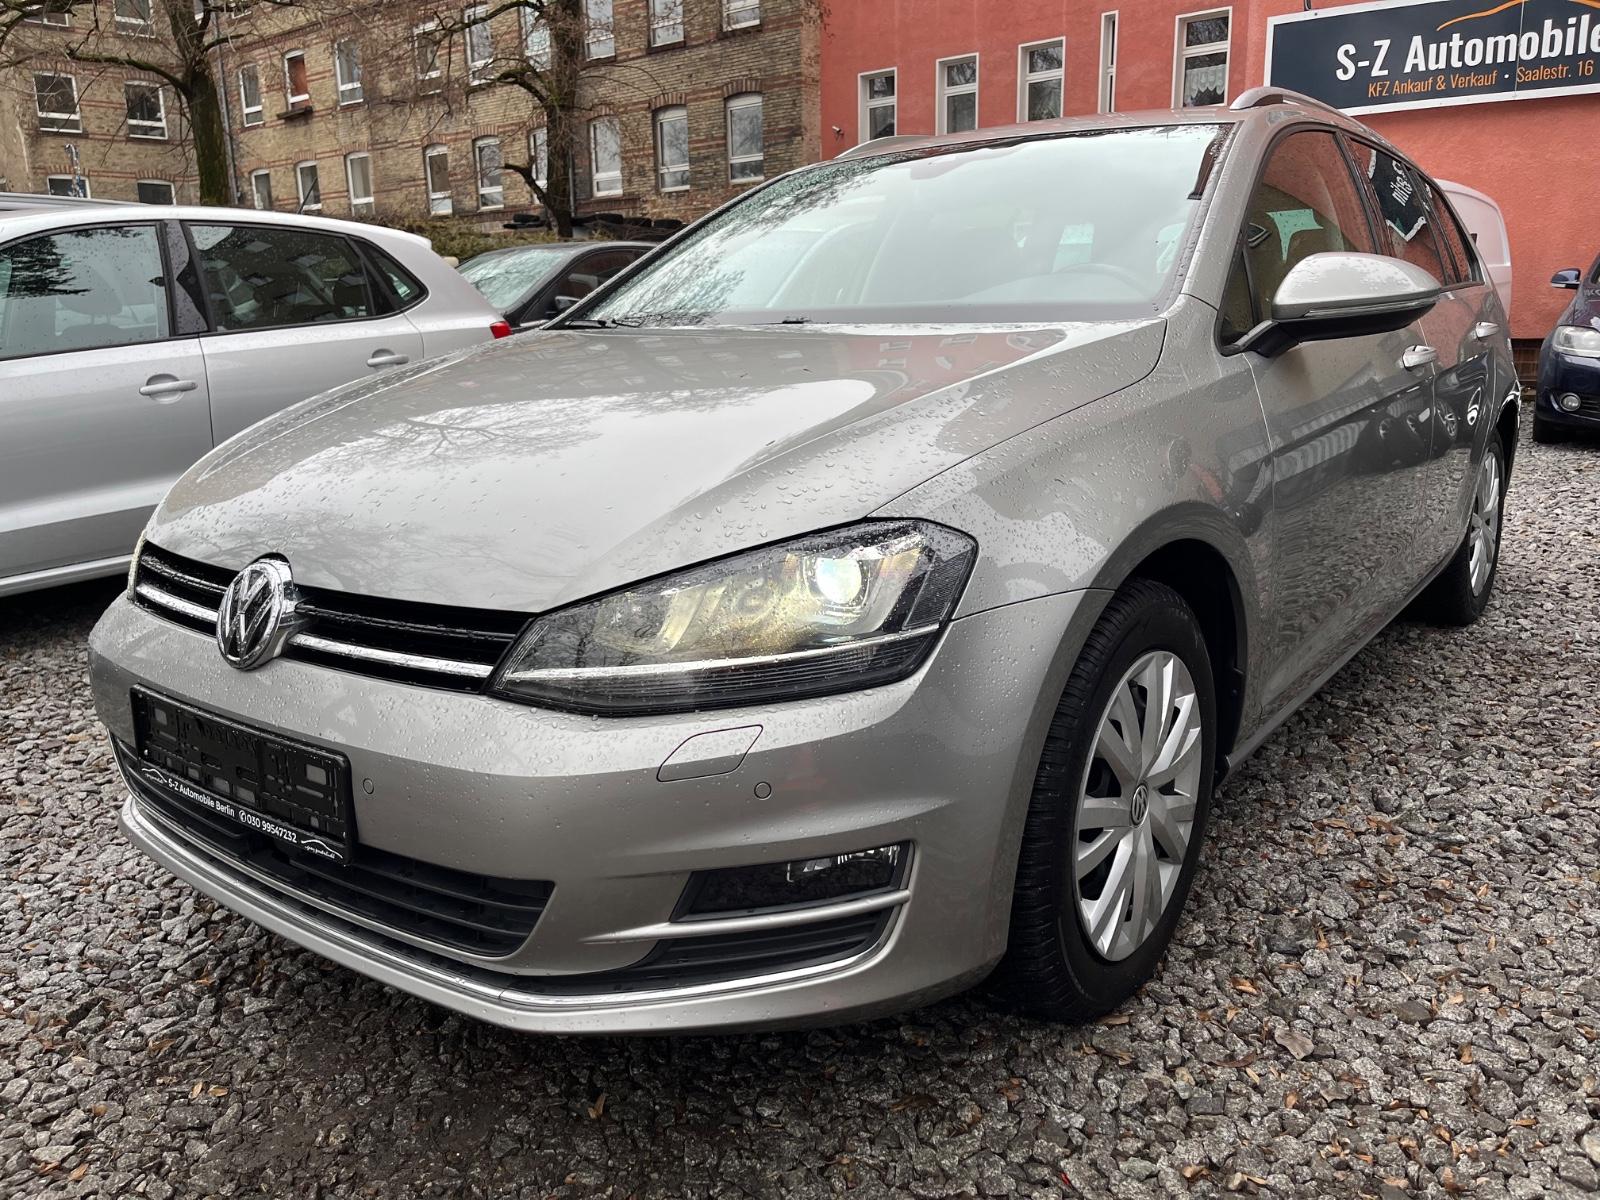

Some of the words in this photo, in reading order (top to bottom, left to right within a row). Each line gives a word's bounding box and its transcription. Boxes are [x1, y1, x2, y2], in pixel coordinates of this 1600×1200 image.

[1336, 39, 1391, 81] S-Z
[1368, 81, 1390, 98] KFZ
[1392, 78, 1433, 96] Ankauf
[1436, 75, 1446, 90] &
[1450, 71, 1498, 90] Verkauf
[1517, 64, 1572, 83] Saalestr.
[1577, 60, 1594, 77] 16
[168, 778, 179, 791] S-Z
[179, 784, 214, 808] Automobile
[215, 801, 235, 817] Berlin
[246, 814, 261, 828] 030
[261, 820, 298, 844] 99547232
